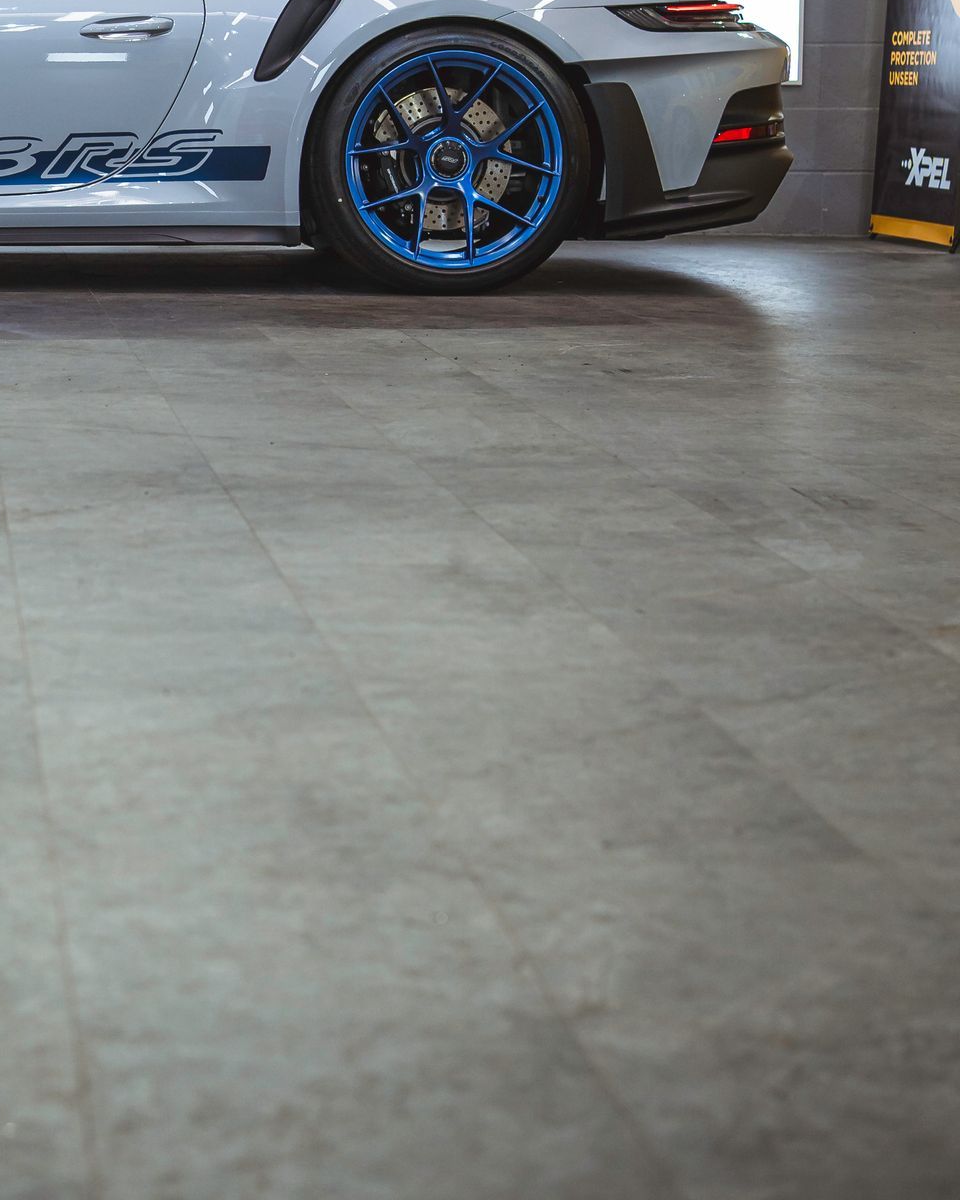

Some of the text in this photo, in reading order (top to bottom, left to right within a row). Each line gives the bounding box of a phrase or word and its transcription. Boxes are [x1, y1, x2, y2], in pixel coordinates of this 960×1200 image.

[891, 30, 931, 46] COMPLETE
[890, 50, 937, 66] PROTECTION
[889, 71, 918, 86] UNSEEN
[905, 147, 951, 190] XPEL
